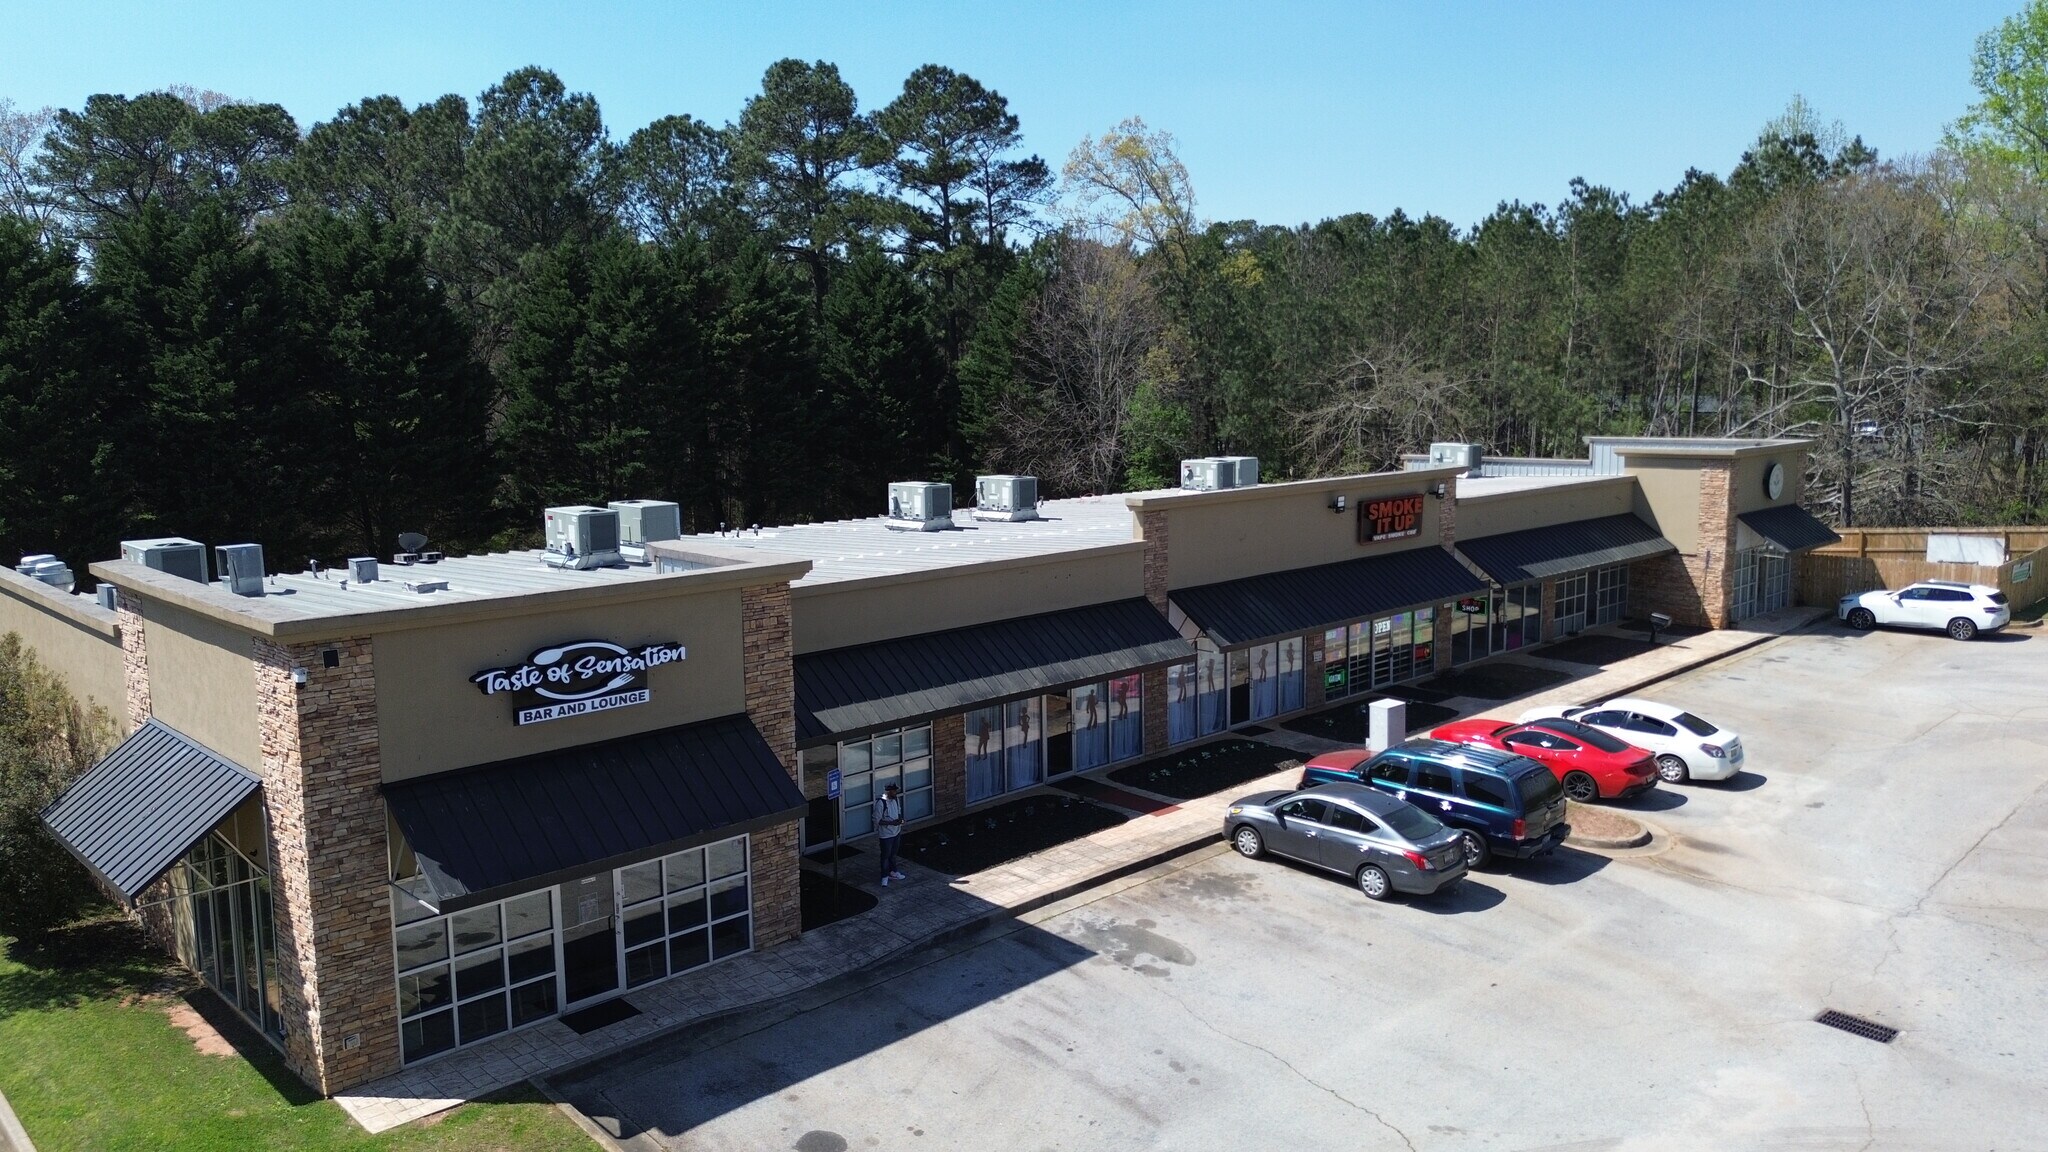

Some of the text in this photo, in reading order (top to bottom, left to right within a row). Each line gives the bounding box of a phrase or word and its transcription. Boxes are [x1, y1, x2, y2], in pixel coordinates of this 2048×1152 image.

[1368, 498, 1422, 520] SMOKE
[1377, 514, 1415, 534] IT UP
[475, 645, 686, 695] Taste of Sensation
[523, 691, 647, 723] BAR AND LOUNGE
